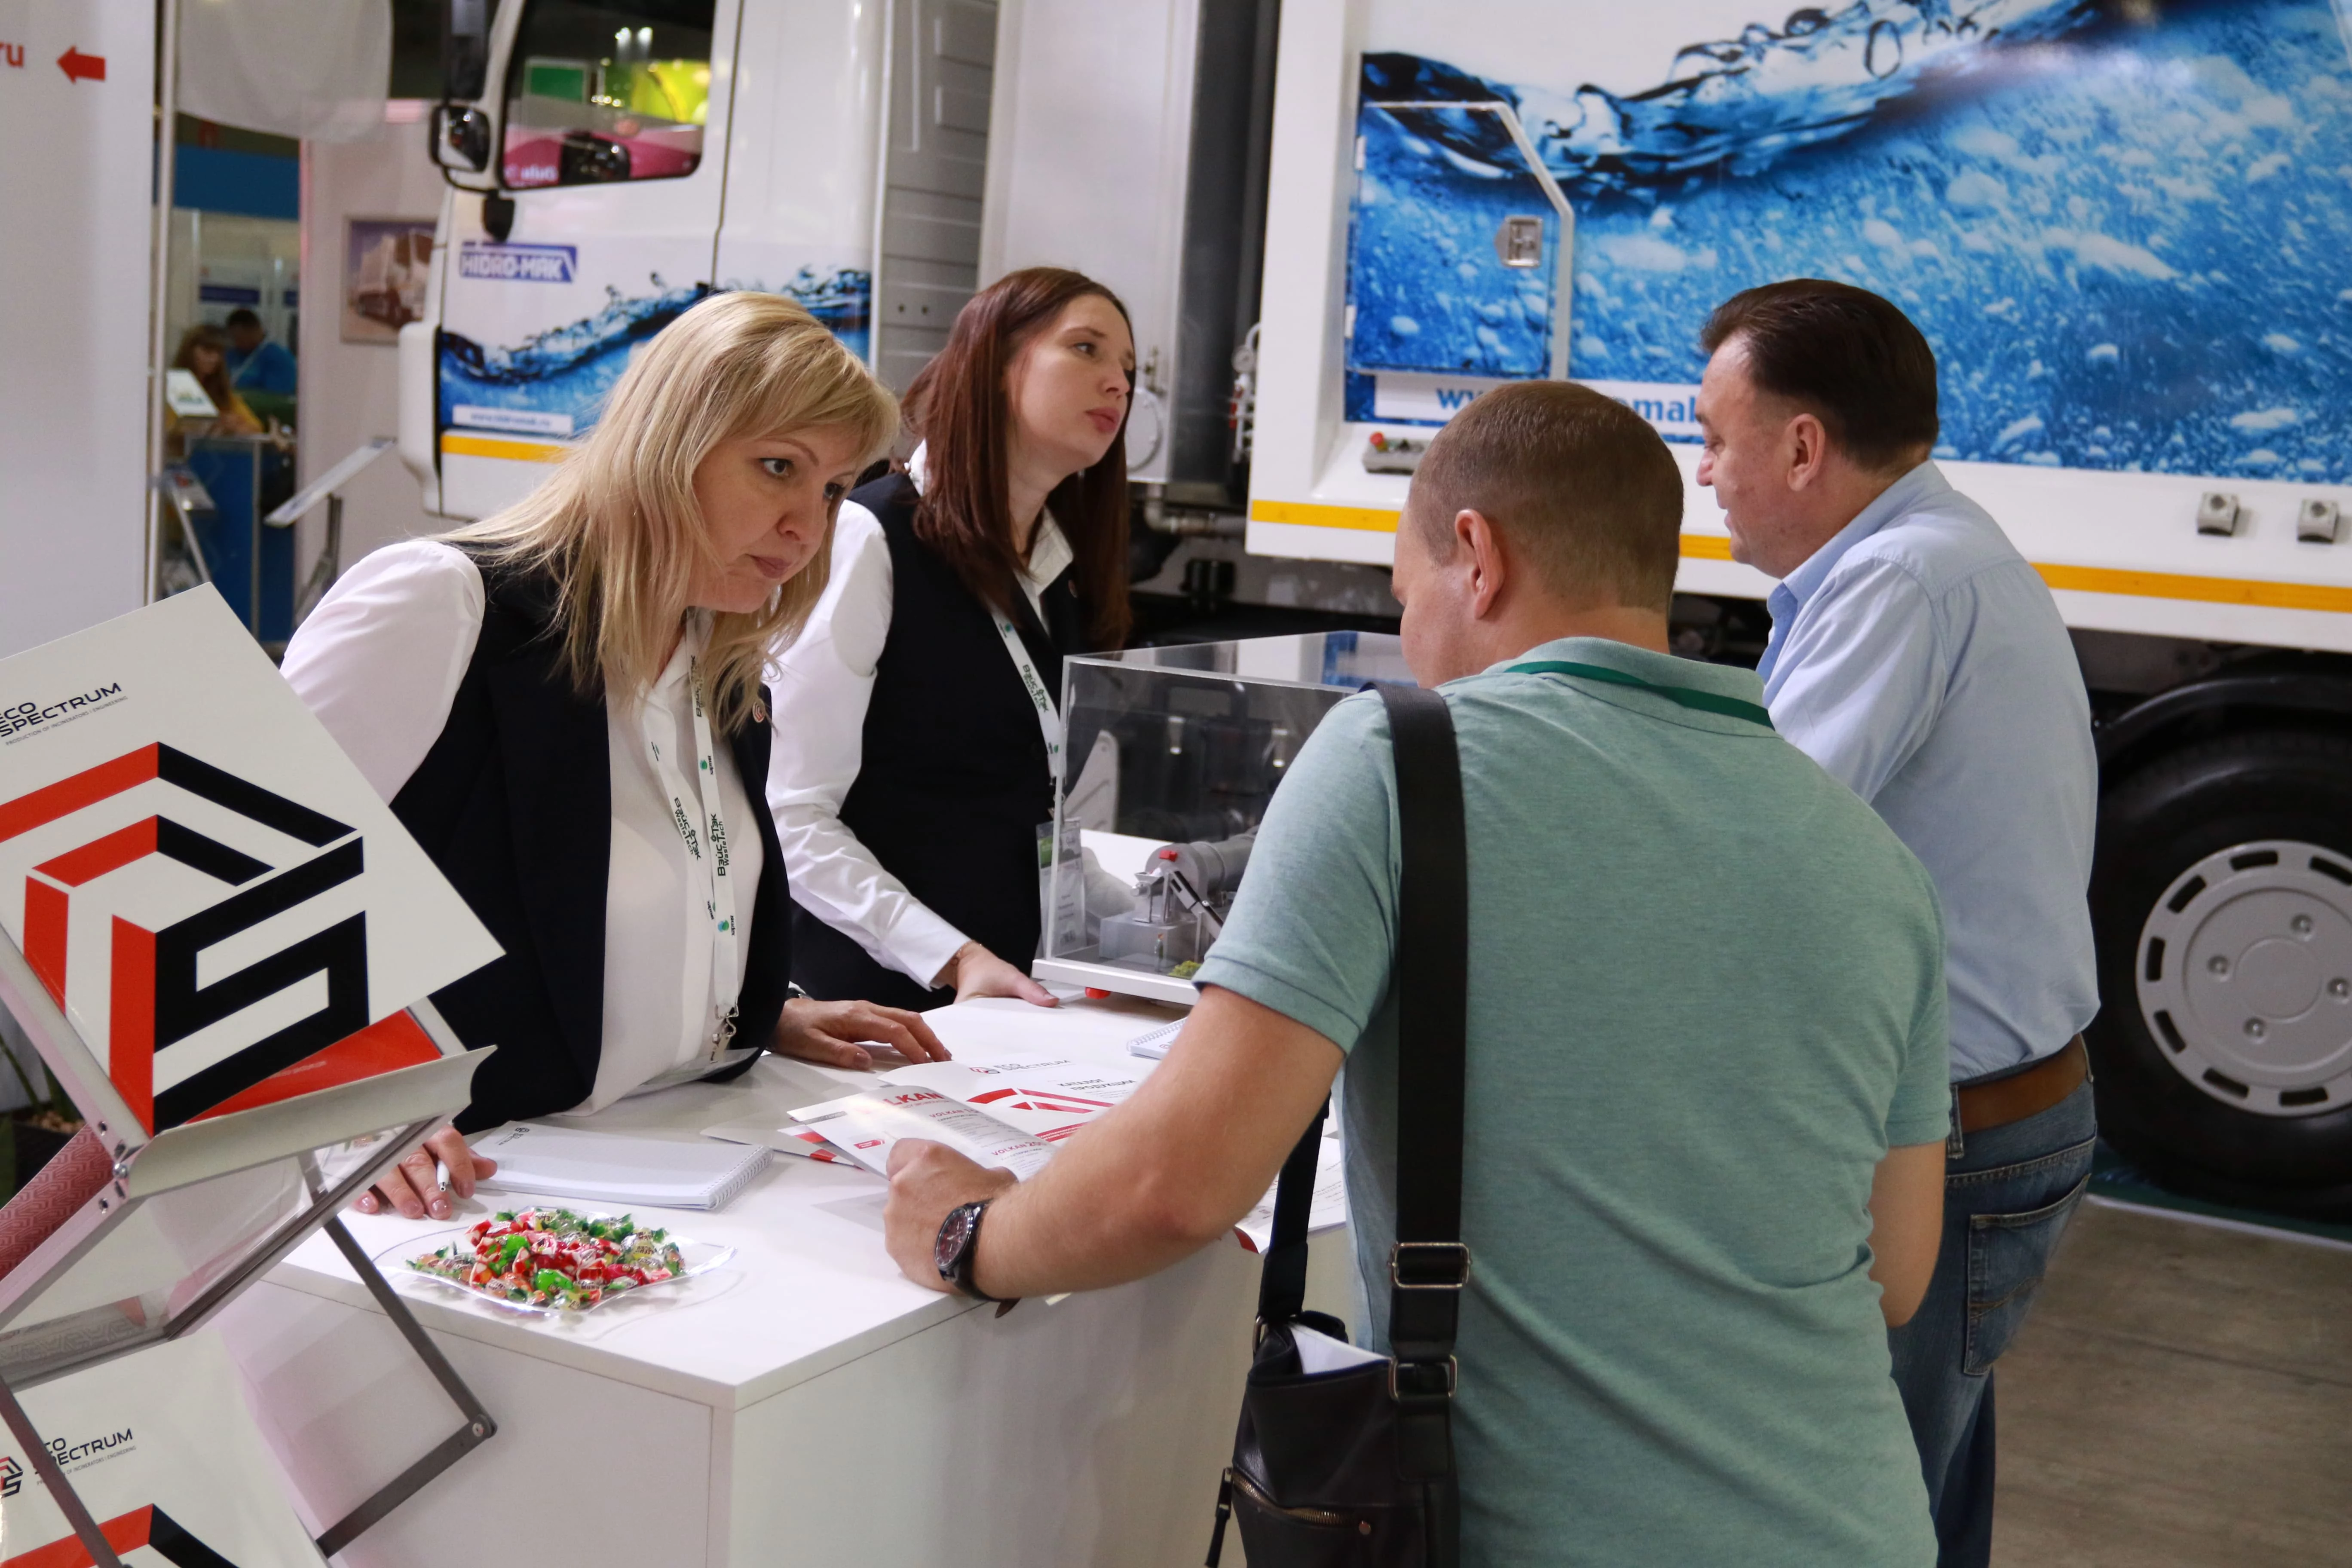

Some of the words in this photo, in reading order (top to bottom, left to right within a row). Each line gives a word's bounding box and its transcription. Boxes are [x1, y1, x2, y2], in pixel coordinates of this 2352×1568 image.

[0, 682, 122, 737] SPECTRUM
[6, 729, 42, 746] PRODUCTION
[51, 710, 89, 729] INCINERATORS
[92, 695, 128, 713] ENGINEERING
[675, 808, 695, 855] WasteTech
[718, 821, 729, 866] WasteTech
[991, 1144, 1027, 1156] VOLKAN
[107, 1445, 136, 1460] ENGINEERING
